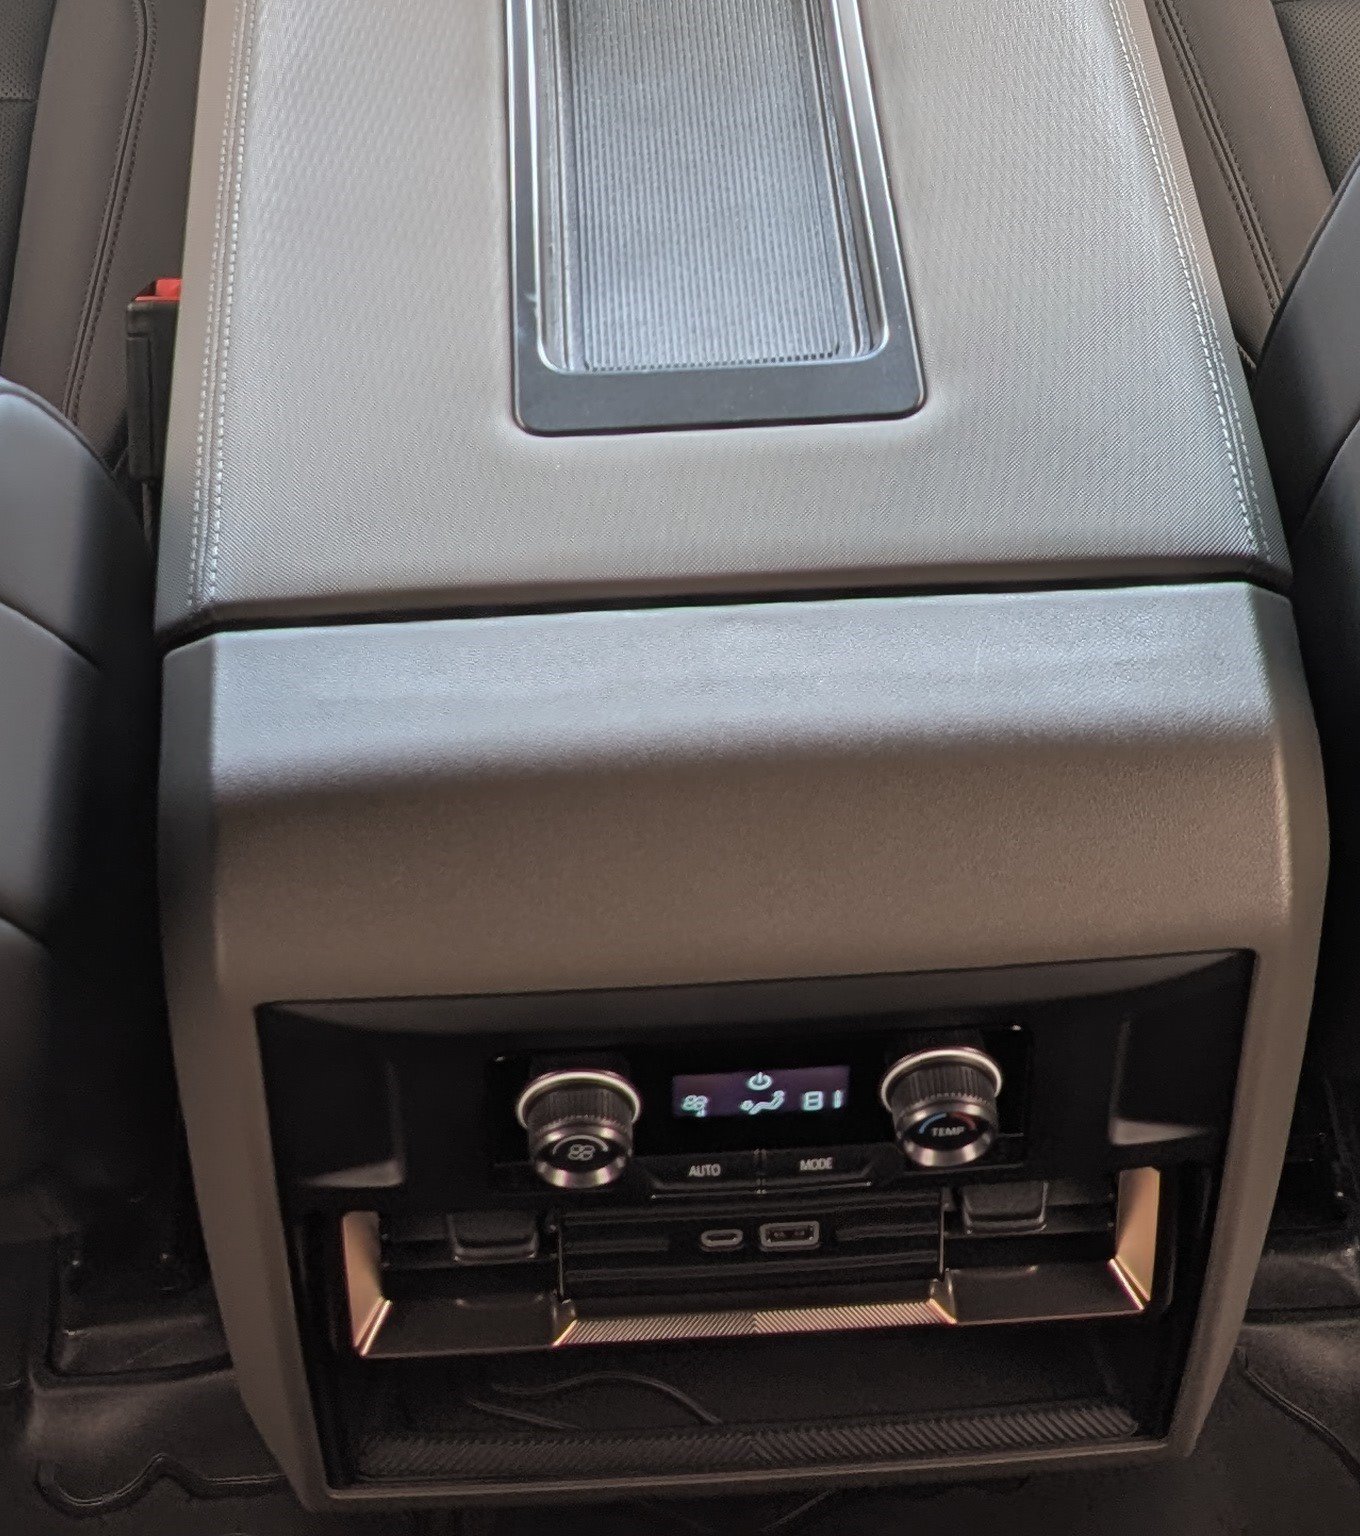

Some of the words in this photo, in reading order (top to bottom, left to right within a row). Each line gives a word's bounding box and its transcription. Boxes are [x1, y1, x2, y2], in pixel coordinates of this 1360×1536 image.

[932, 1125, 965, 1138] TEMP
[689, 1163, 721, 1178] AUTO
[800, 1157, 833, 1172] MODE
